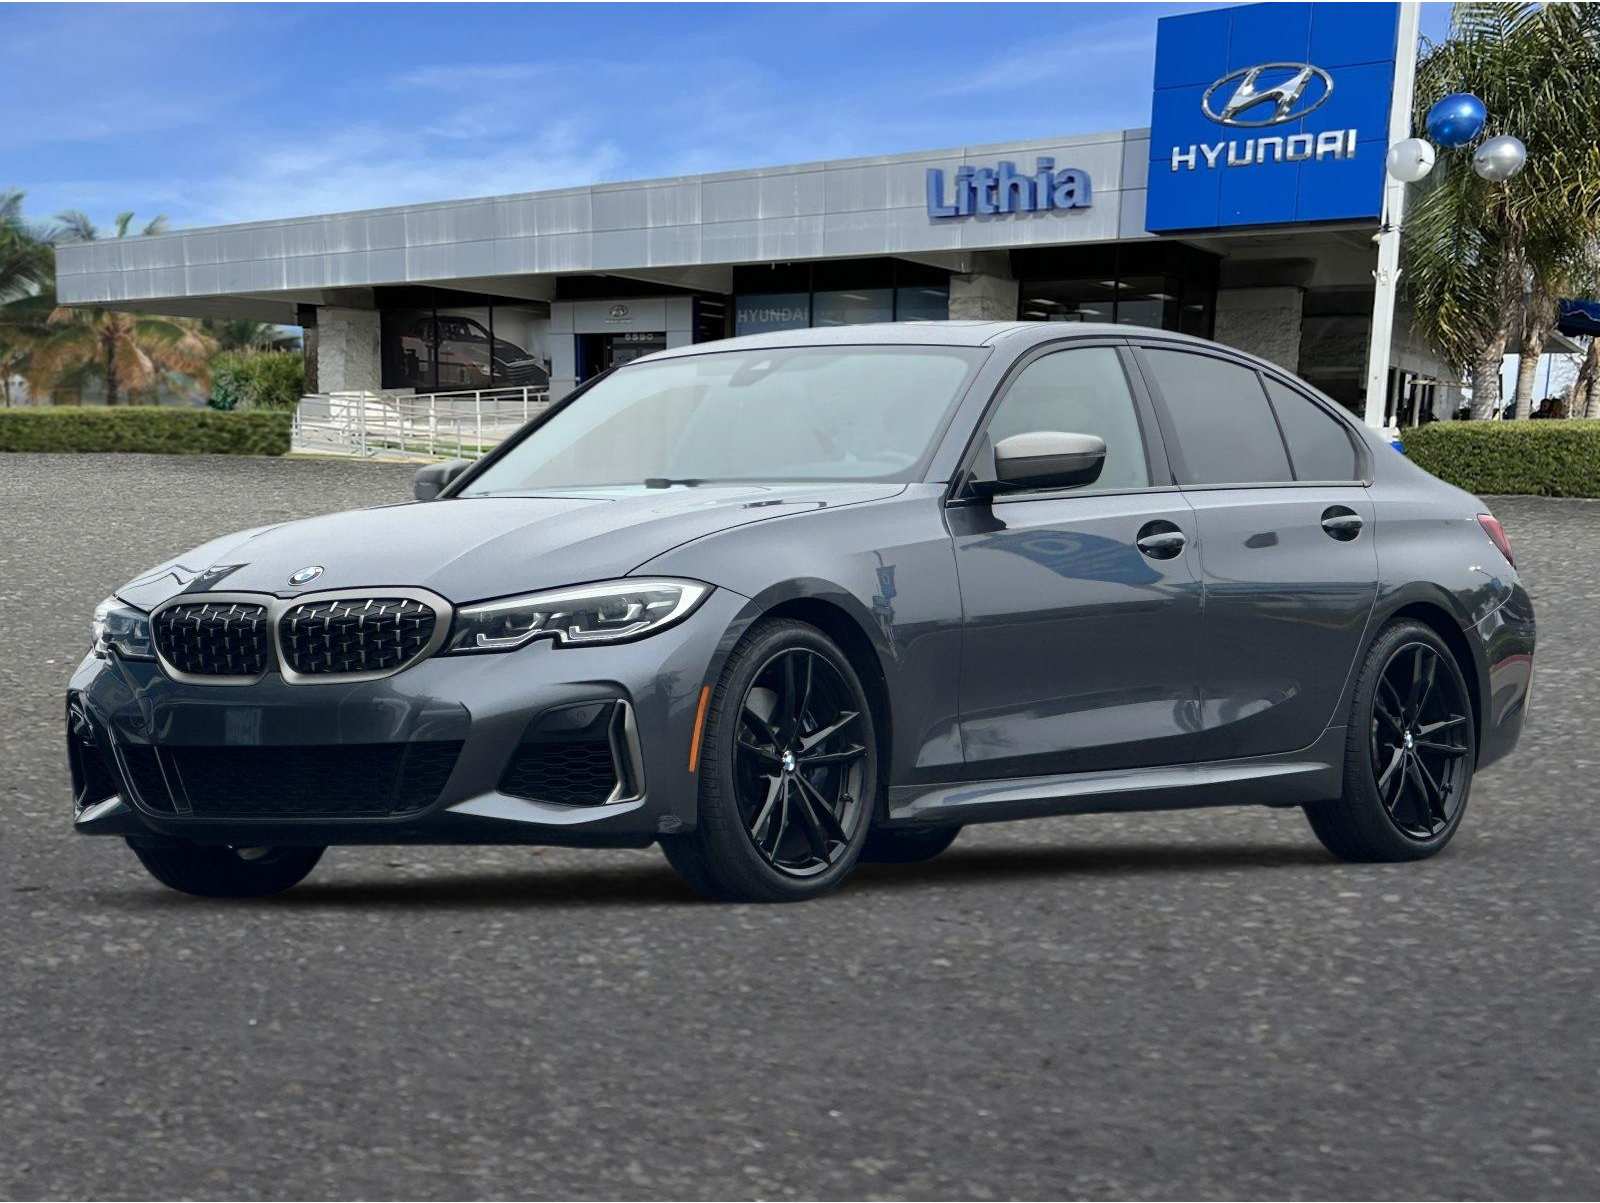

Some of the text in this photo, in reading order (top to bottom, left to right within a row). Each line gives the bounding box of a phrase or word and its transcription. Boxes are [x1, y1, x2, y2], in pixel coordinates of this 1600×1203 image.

[1171, 129, 1357, 172] HYUNDAI
[926, 157, 1093, 219] Lithia
[737, 307, 809, 323] HYUNDAI
